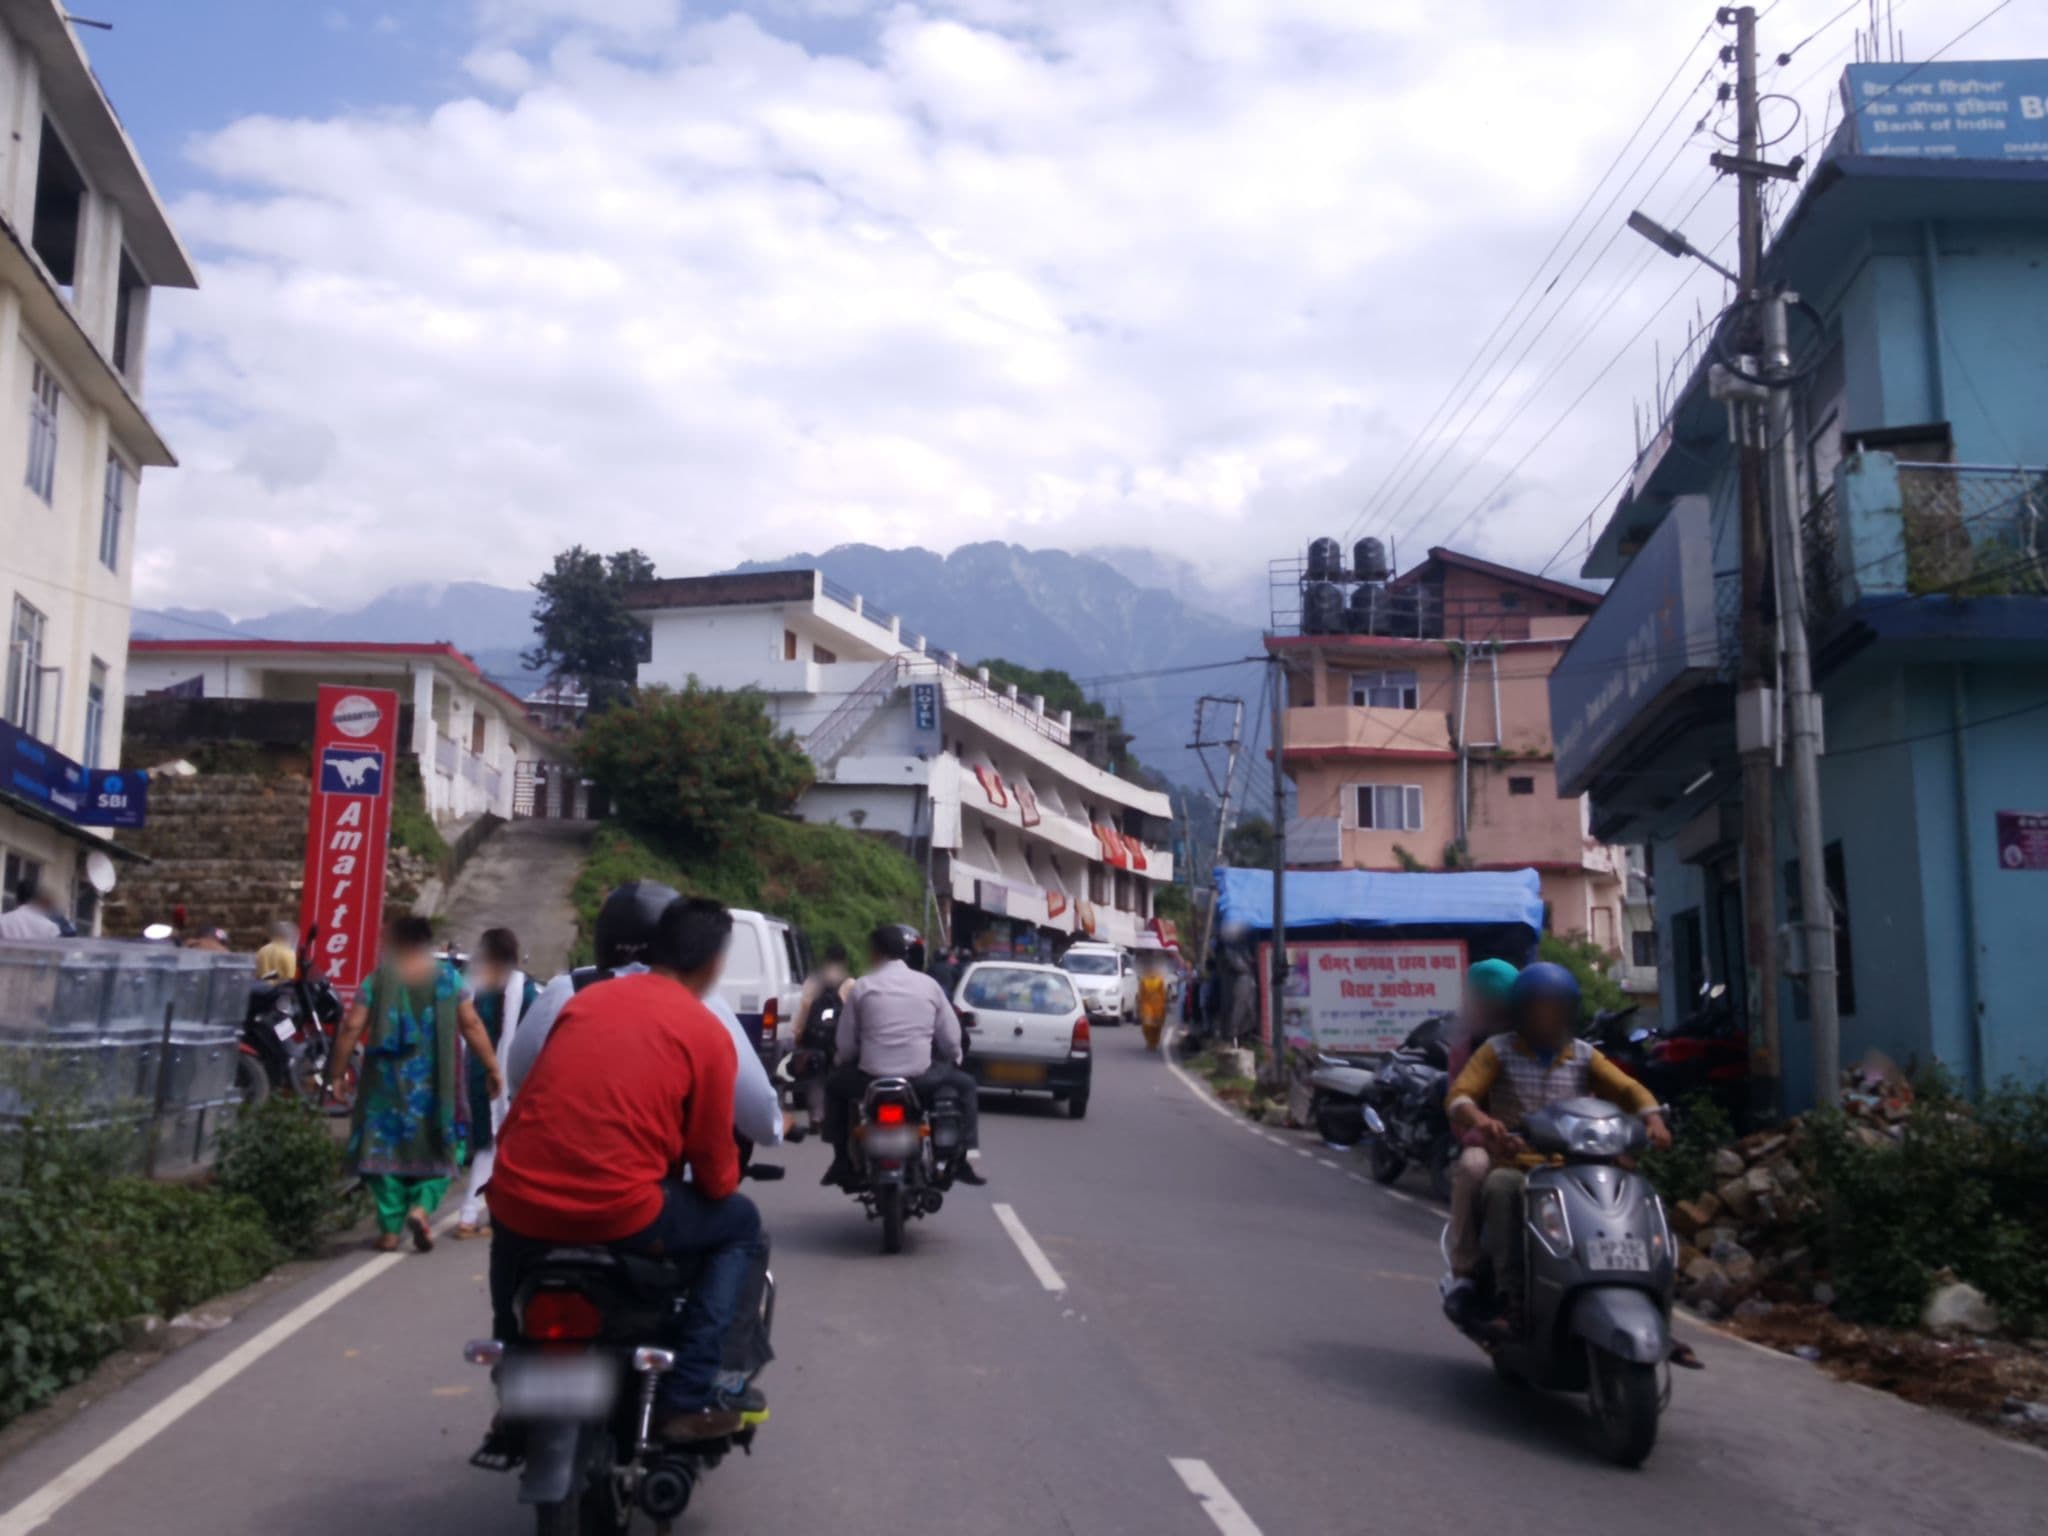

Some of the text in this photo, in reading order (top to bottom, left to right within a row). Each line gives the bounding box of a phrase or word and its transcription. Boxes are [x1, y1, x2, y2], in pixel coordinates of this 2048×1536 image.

[1873, 118, 2005, 133] Bank of India
[917, 686, 932, 728] HOTEL
[98, 794, 128, 808] SBI
[325, 801, 363, 978] Amartex
[1379, 978, 1436, 998] आयोजन
